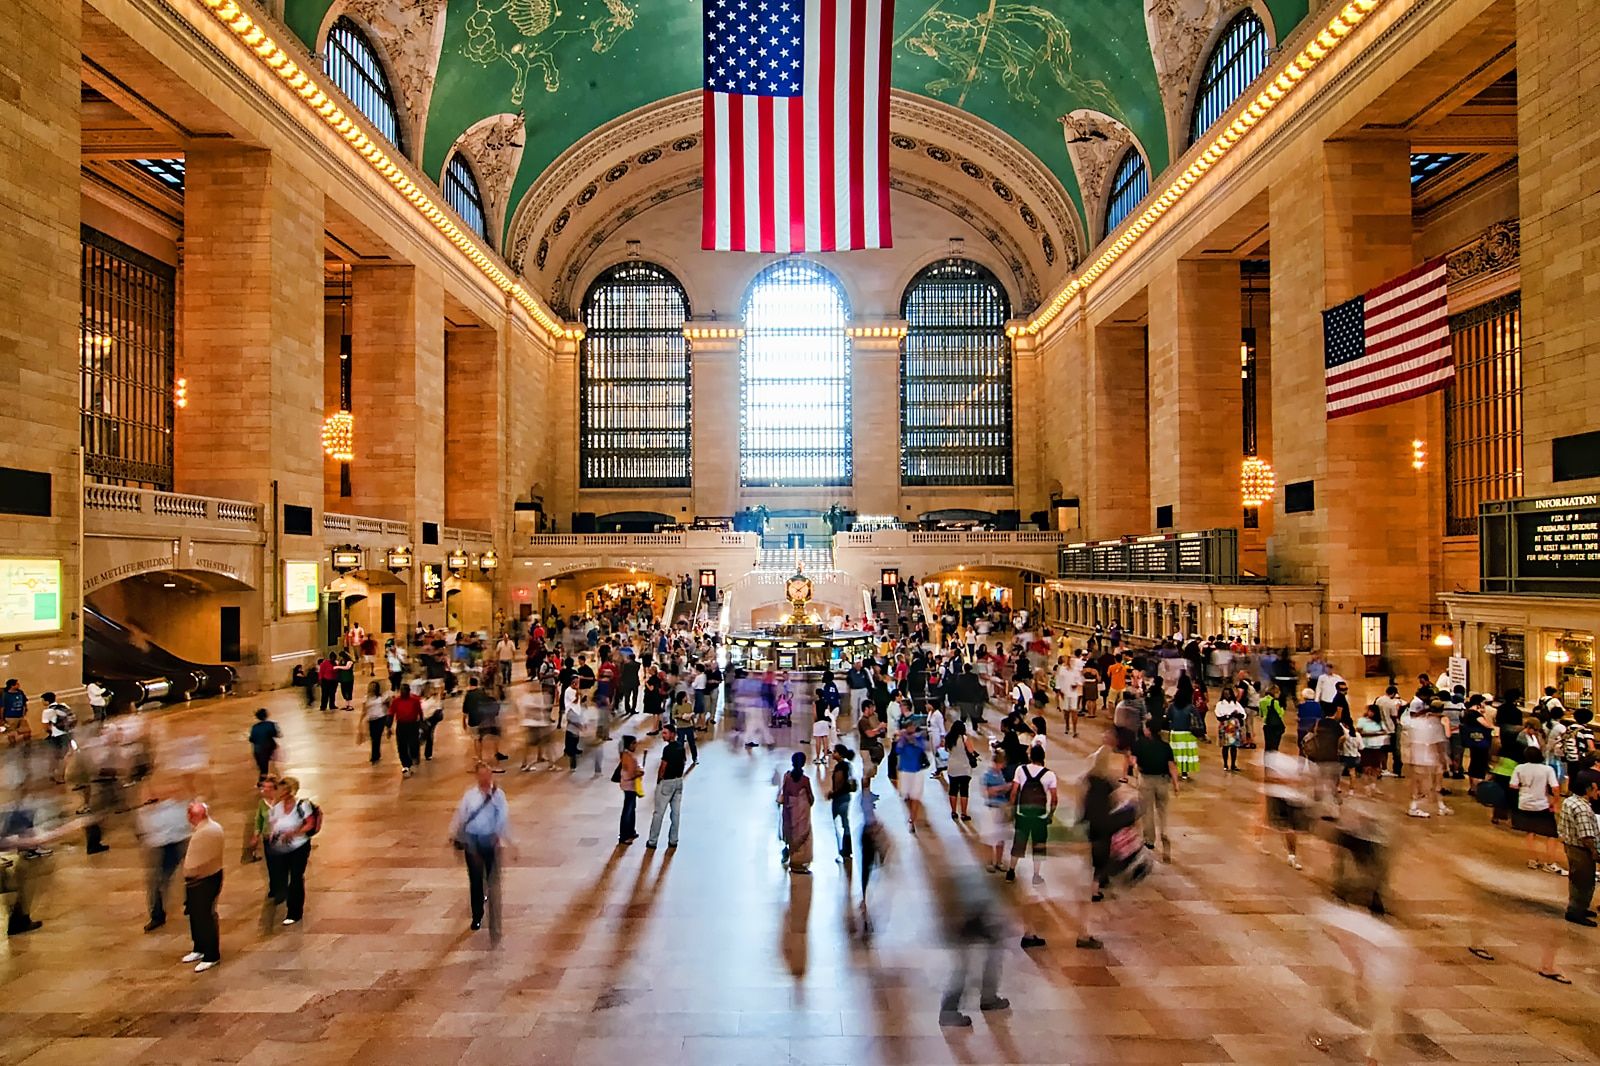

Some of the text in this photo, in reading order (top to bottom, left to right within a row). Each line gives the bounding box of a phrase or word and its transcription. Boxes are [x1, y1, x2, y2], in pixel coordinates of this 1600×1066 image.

[1535, 495, 1597, 508] INFORMATION
[1543, 534, 1553, 542] THE
[1566, 533, 1579, 541] INFO
[1580, 533, 1598, 541] BOOTH
[100, 563, 136, 582] METLIFE
[136, 557, 173, 571] BUILDING
[213, 561, 236, 574] STREET
